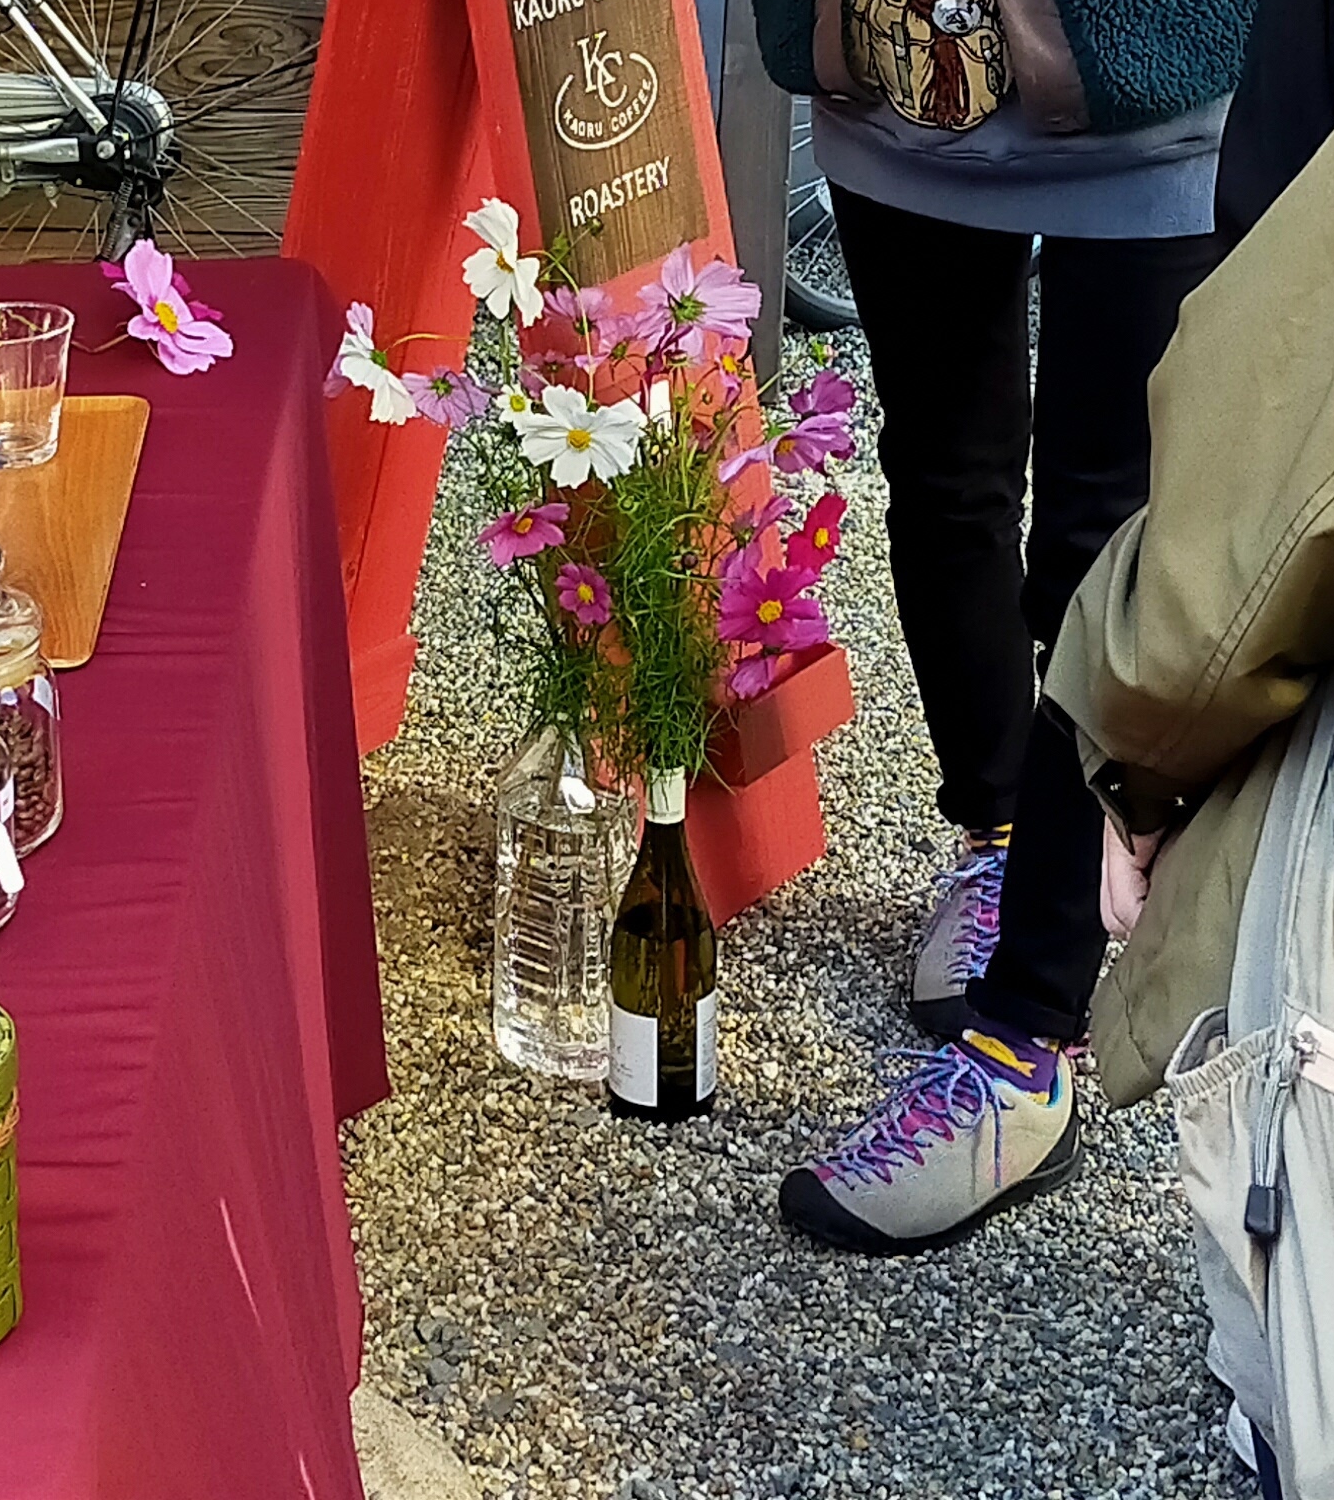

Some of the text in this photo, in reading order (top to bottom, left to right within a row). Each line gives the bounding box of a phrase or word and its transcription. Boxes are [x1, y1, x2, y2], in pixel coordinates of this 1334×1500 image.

[563, 78, 651, 138] KAORU COFFEE
[569, 156, 671, 228] ROASTERY
